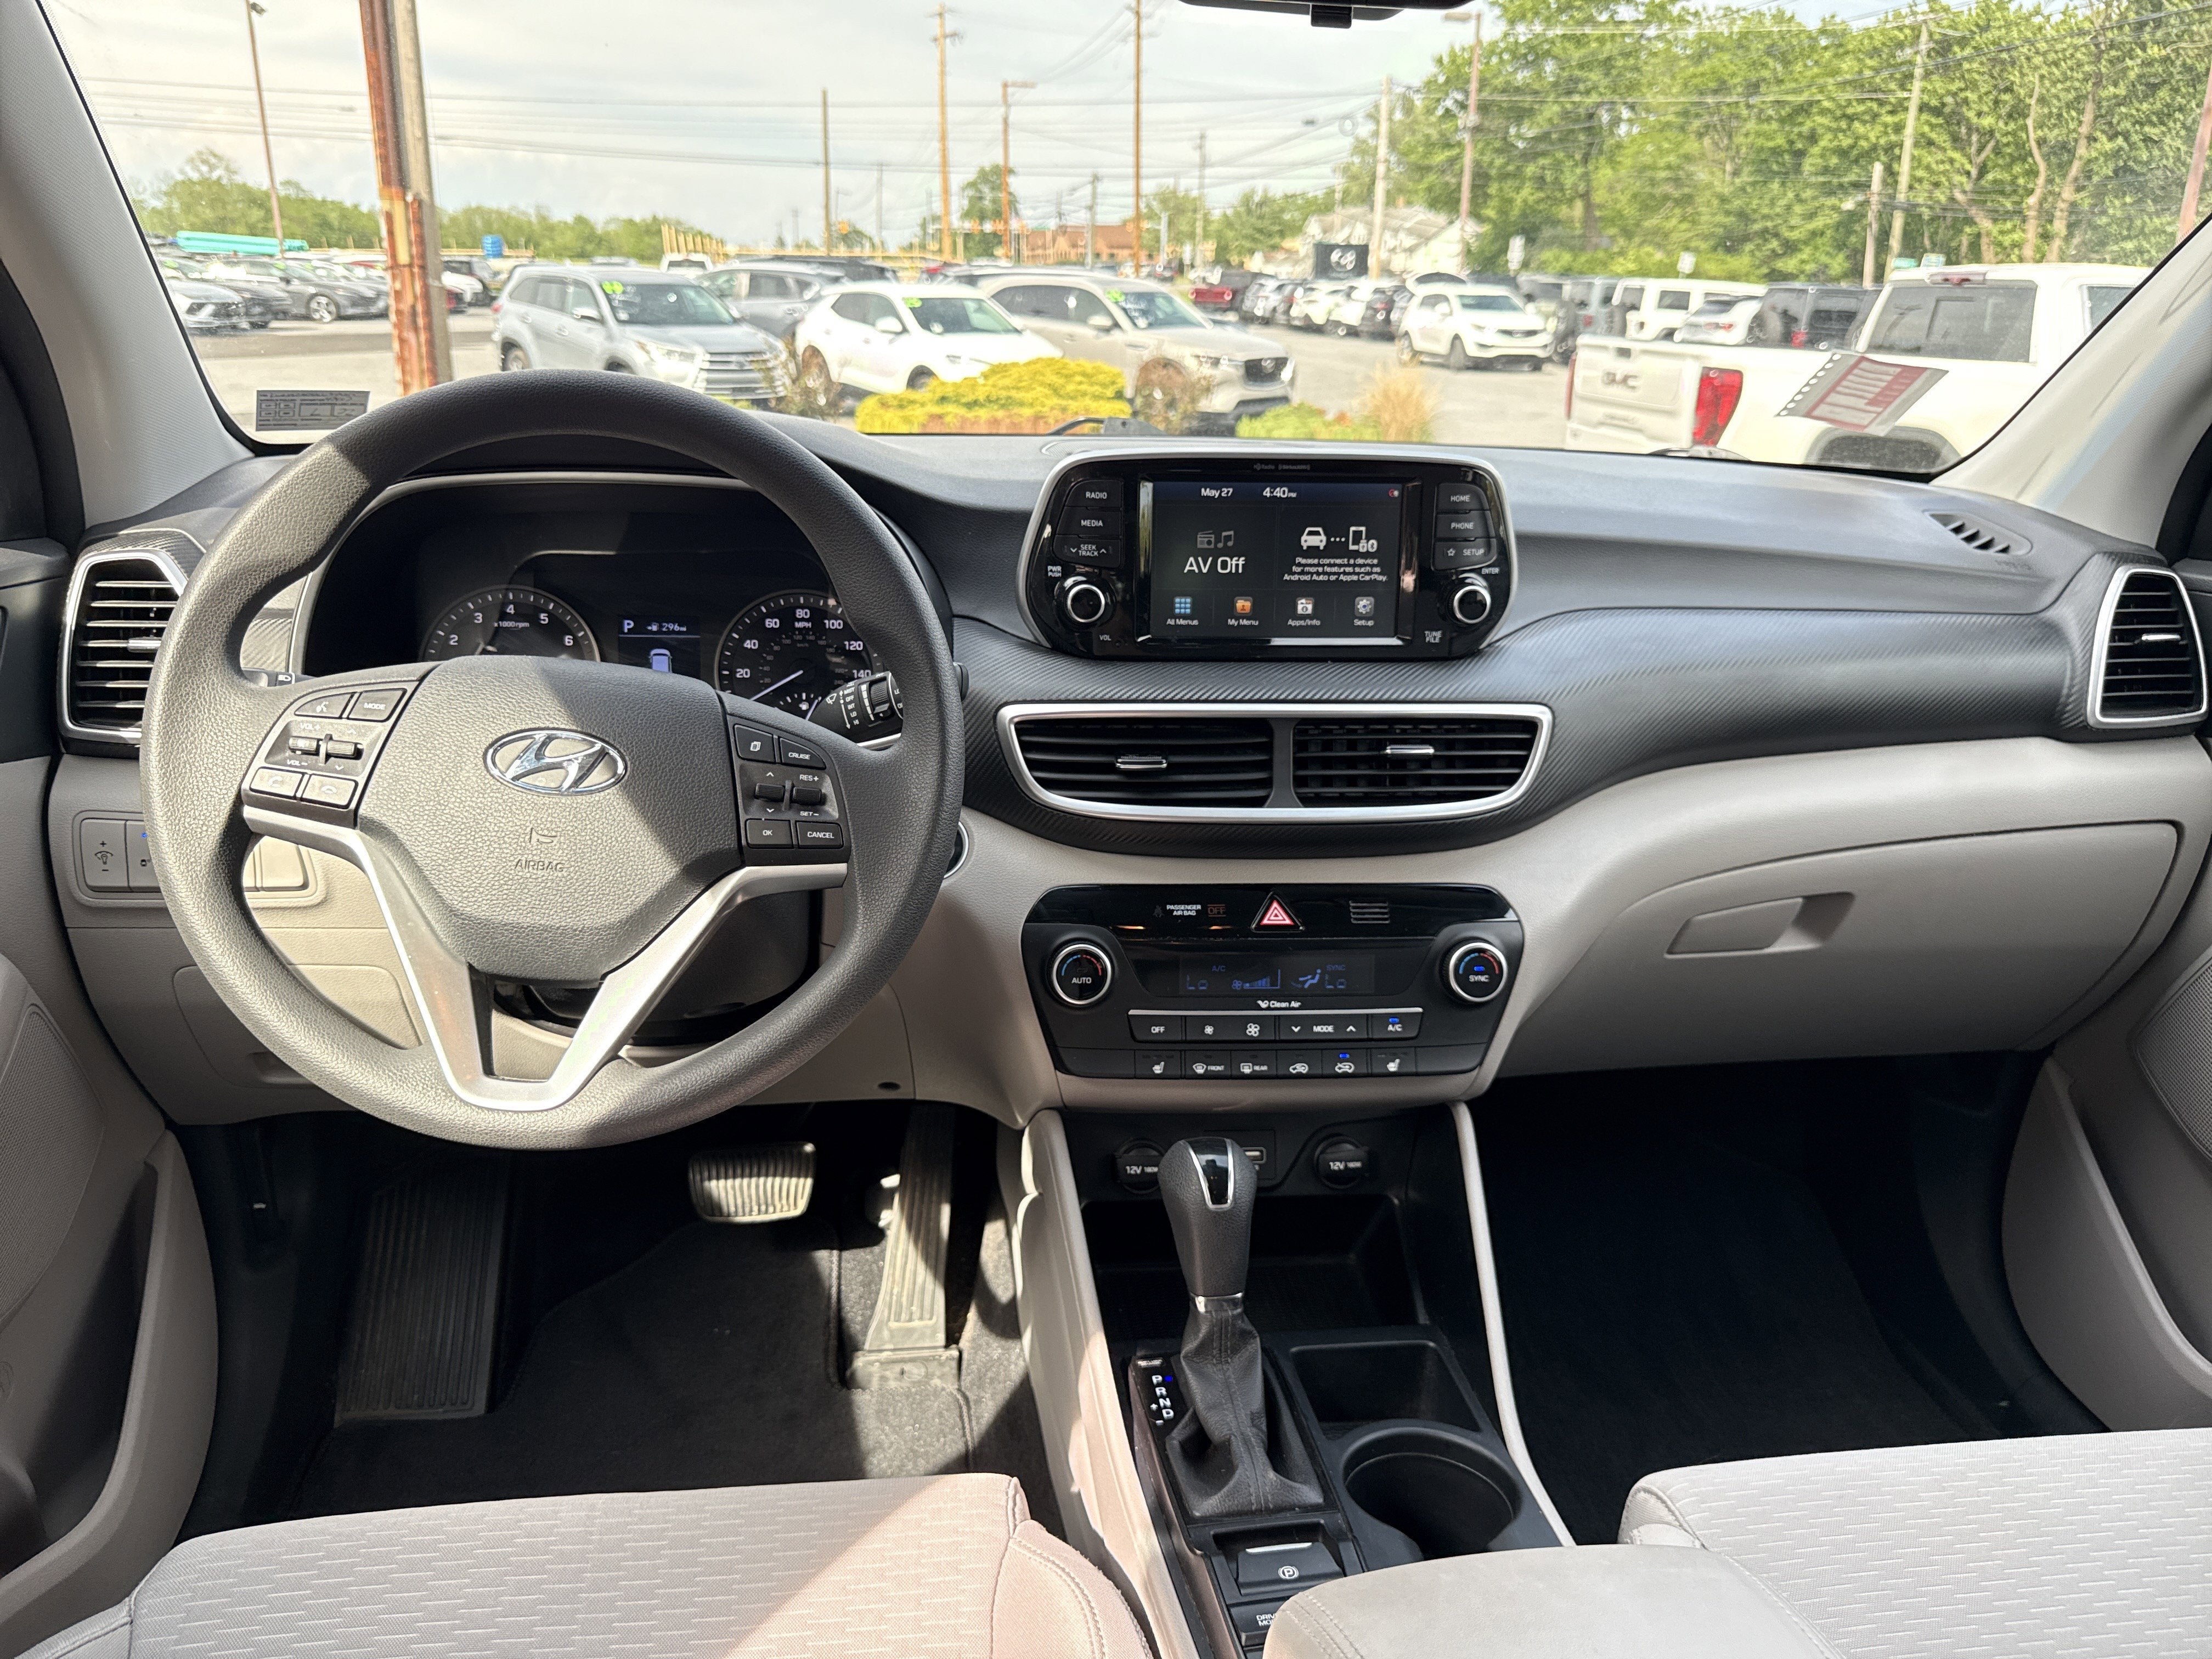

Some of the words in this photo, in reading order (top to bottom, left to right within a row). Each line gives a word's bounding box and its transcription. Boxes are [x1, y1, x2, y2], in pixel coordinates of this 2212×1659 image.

[1201, 488, 1220, 499] May
[1221, 488, 1233, 496] 27
[1183, 556, 1213, 573] AV
[1217, 556, 1246, 573] Off
[506, 605, 515, 614] 4
[795, 609, 810, 618] 80
[473, 613, 483, 623] 3
[539, 613, 549, 624] 5
[765, 618, 780, 628] 60
[1228, 618, 1238, 627] My
[624, 619, 634, 633] P
[824, 620, 843, 629] 100
[449, 635, 458, 645] 2
[564, 636, 573, 646] 6
[743, 640, 759, 649] 40
[844, 641, 864, 651] 120
[736, 668, 751, 678] 20
[853, 669, 871, 679] 140
[788, 752, 811, 760] CRUISE
[515, 859, 565, 872] AIRBAG
[1126, 1165, 1142, 1174] 12V
[1329, 1161, 1345, 1171] 12V
[1152, 1375, 1163, 1386] P
[1155, 1387, 1167, 1397] R
[1159, 1397, 1171, 1408] N
[1162, 1409, 1174, 1420] D
